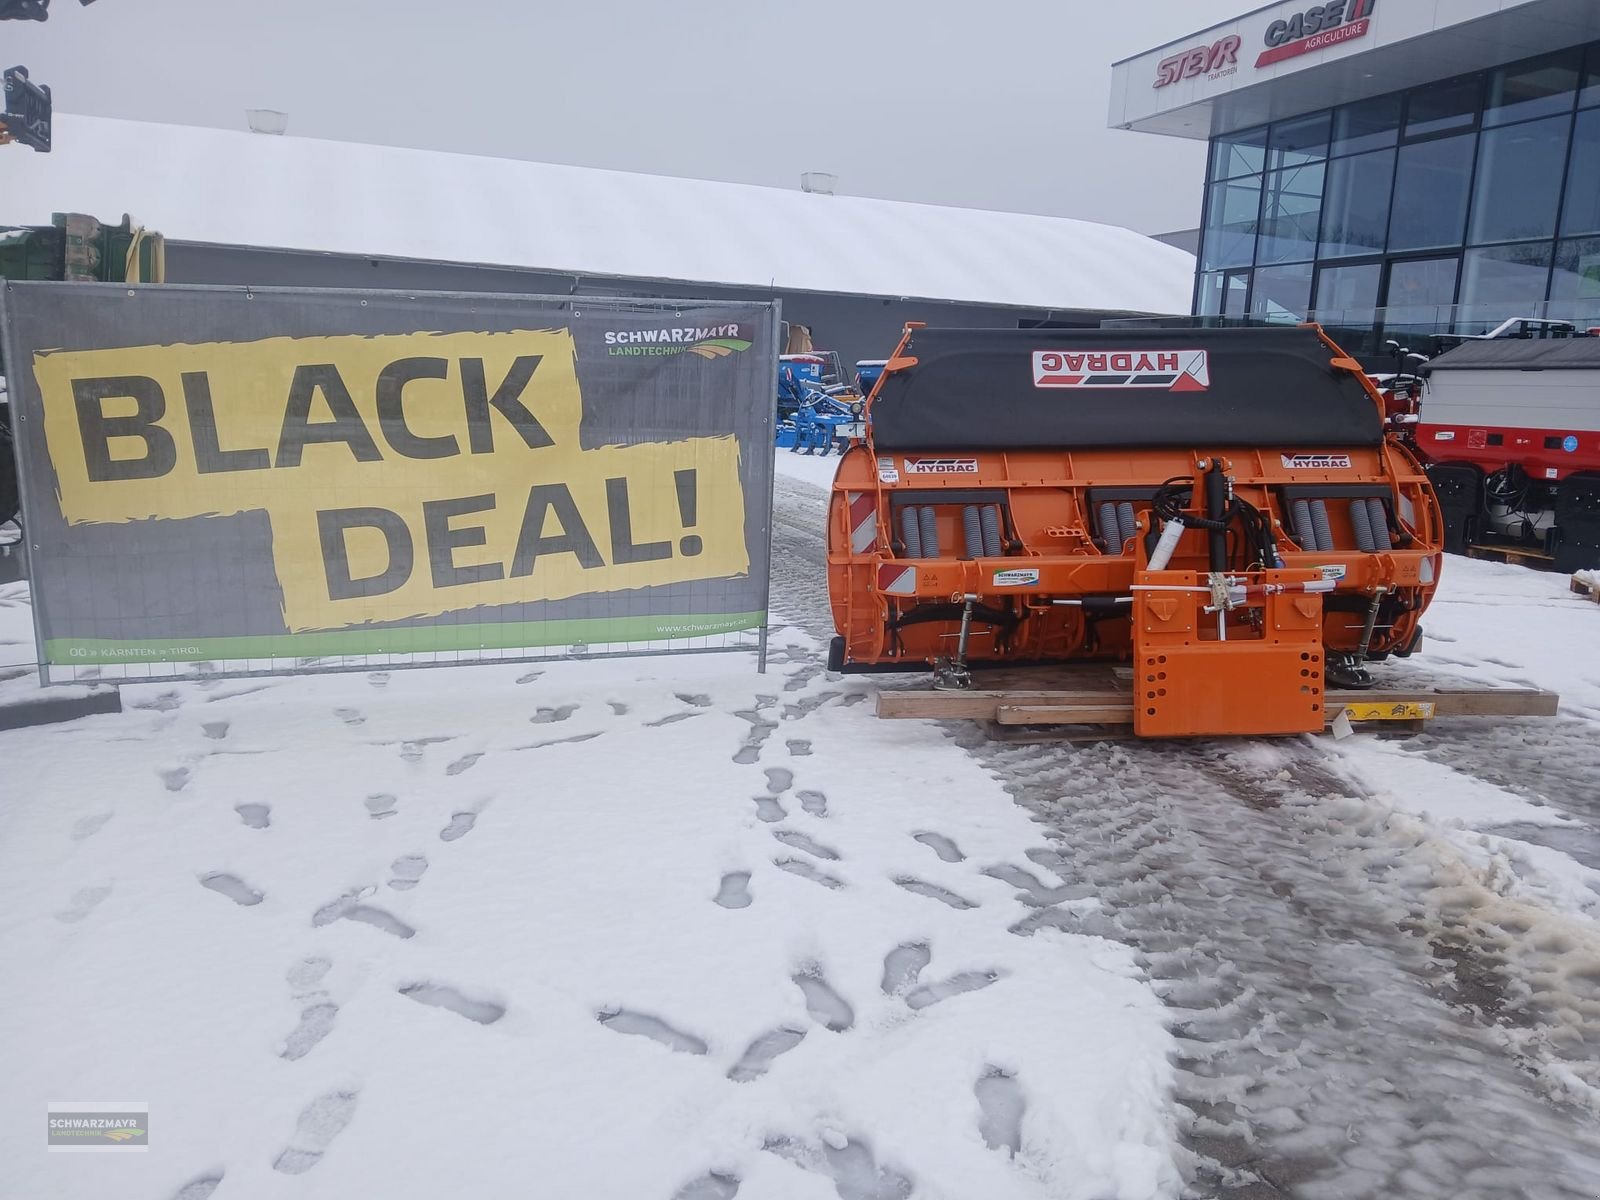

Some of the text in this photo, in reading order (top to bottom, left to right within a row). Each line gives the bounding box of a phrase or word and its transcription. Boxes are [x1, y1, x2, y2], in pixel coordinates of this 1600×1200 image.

[1264, 0, 1347, 47] CASE
[1304, 22, 1362, 50] AGRICULTURE
[1153, 35, 1241, 88] STEYR
[1207, 68, 1238, 82] TRAKTOREN
[604, 324, 739, 344] SCHWARZMAYR
[608, 346, 687, 356] LANDTECHNIK
[1041, 353, 1179, 372] HYDRAC
[70, 355, 555, 482] BLACK
[916, 464, 975, 472] HYDRAC
[1293, 460, 1348, 468] HYDRAC
[315, 468, 703, 601] DEAL!
[656, 619, 747, 633] www.schwarzmayr.at
[169, 646, 203, 655] TIROL
